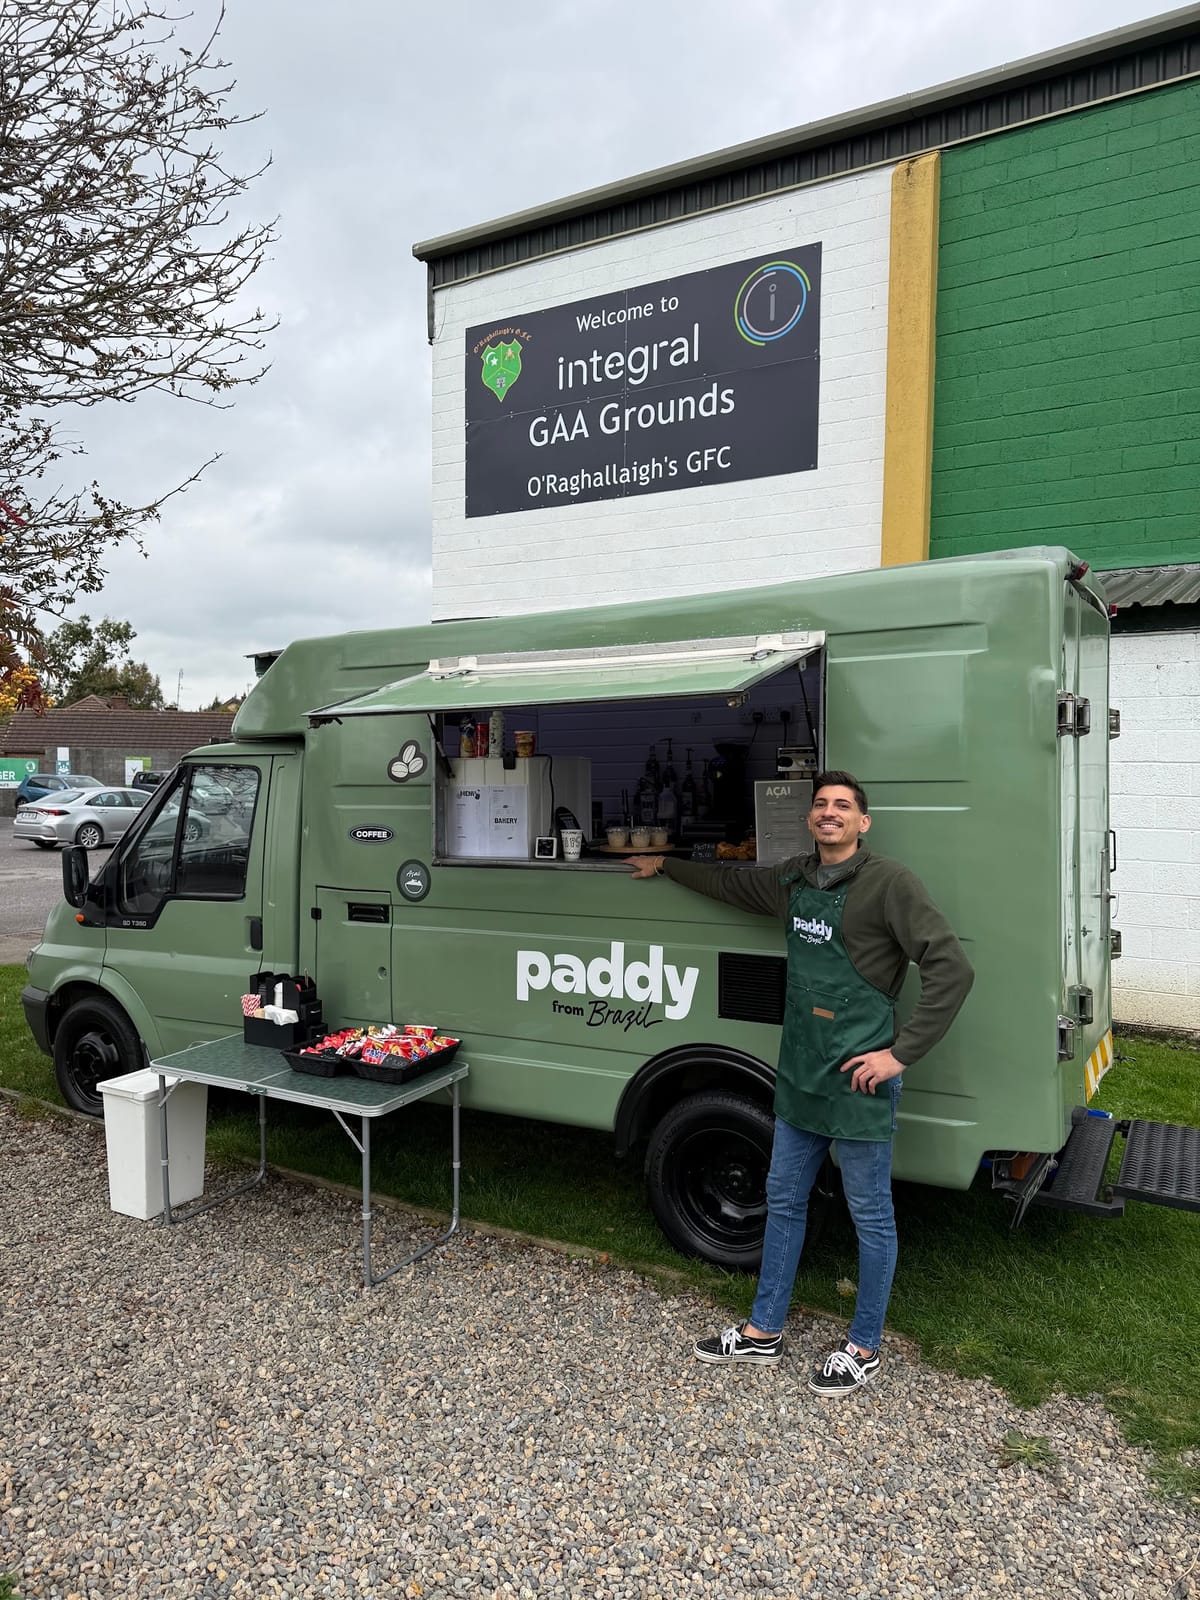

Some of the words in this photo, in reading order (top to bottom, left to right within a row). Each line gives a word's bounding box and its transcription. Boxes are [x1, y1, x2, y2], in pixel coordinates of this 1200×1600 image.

[576, 302, 654, 333] Welcome
[660, 296, 679, 313] to
[557, 322, 700, 390] integral
[528, 409, 590, 448] GAA
[599, 382, 736, 434] Grounds
[527, 456, 679, 497] O'Raghallaigh's
[686, 445, 732, 474] GFC
[356, 830, 388, 838] COFFEE
[494, 817, 518, 825] BAKERY
[793, 916, 833, 941] paddy
[516, 941, 700, 1020] paddy
[552, 1000, 585, 1017] from
[586, 1001, 663, 1033] Brazil
